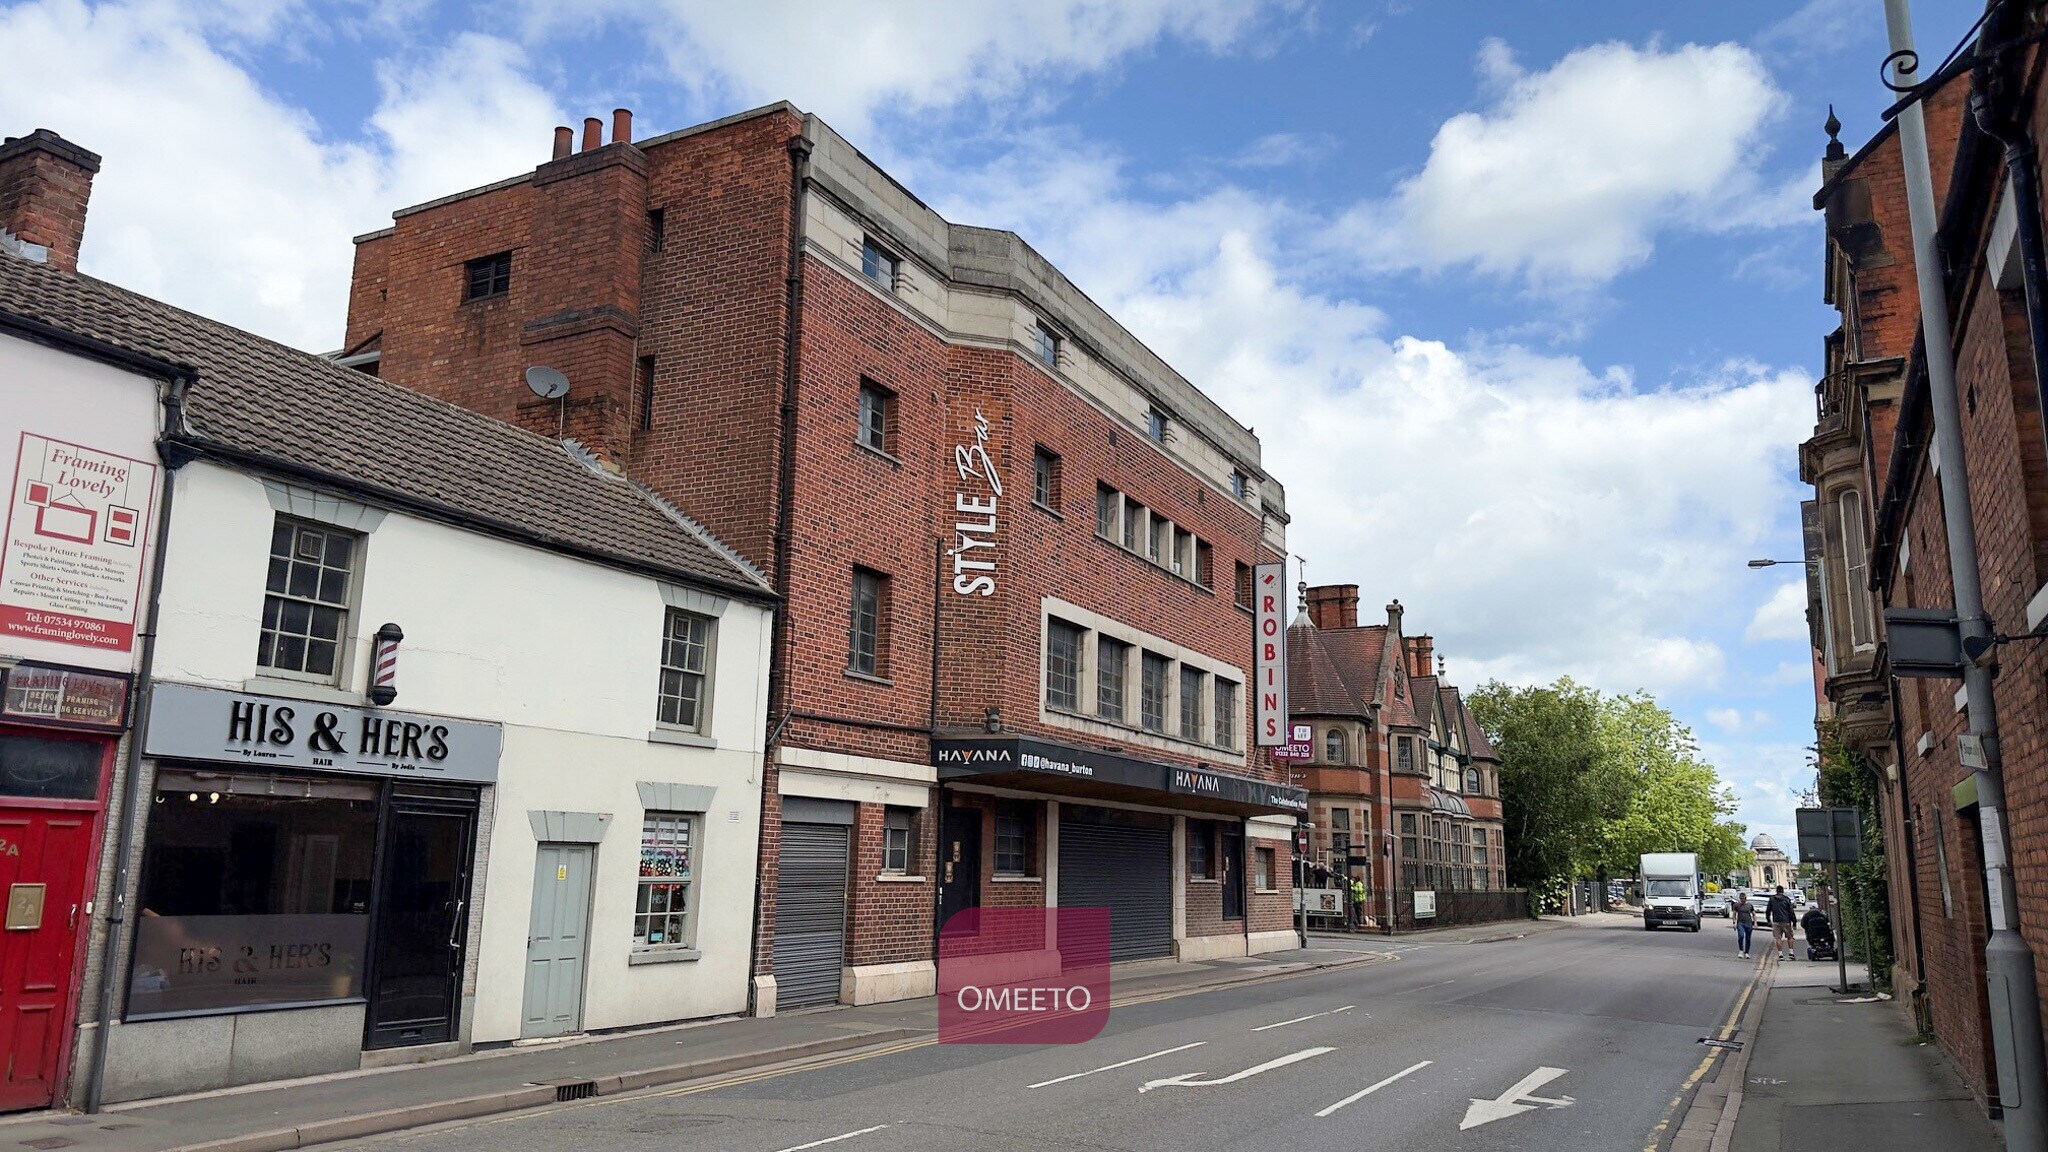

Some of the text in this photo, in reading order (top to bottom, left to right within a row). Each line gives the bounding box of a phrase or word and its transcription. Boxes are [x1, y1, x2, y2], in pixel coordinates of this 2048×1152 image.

[50, 448, 127, 483] Framing
[58, 470, 115, 498] Lovely
[953, 407, 1002, 596] STYLE Bar
[14, 539, 48, 552] Bespoke
[50, 546, 78, 558] Picture
[80, 552, 113, 565] Framing
[50, 557, 76, 567] Paintings
[20, 560, 39, 568] Sports
[30, 572, 55, 583] Other
[57, 576, 88, 588] Services
[25, 612, 106, 632] Tel: 07534 970861
[8, 622, 118, 645] www.framinglovely.com
[1263, 596, 1277, 737] ROBINS
[16, 675, 116, 698] FRAMING LOVELY
[66, 696, 99, 706] FRAMING
[73, 707, 108, 717] SERVICES
[229, 701, 450, 761] HIS & HER'S
[243, 749, 277, 758] By Lauren
[312, 758, 333, 766] HAIR
[938, 750, 1011, 765] HAVANA
[392, 762, 415, 771] By Jodie
[1040, 757, 1093, 776] @havana_burton
[1176, 770, 1219, 793] HAVANA
[18, 897, 34, 917] 2A
[178, 942, 332, 974] HIS & HER'S
[234, 976, 259, 985] HAIR
